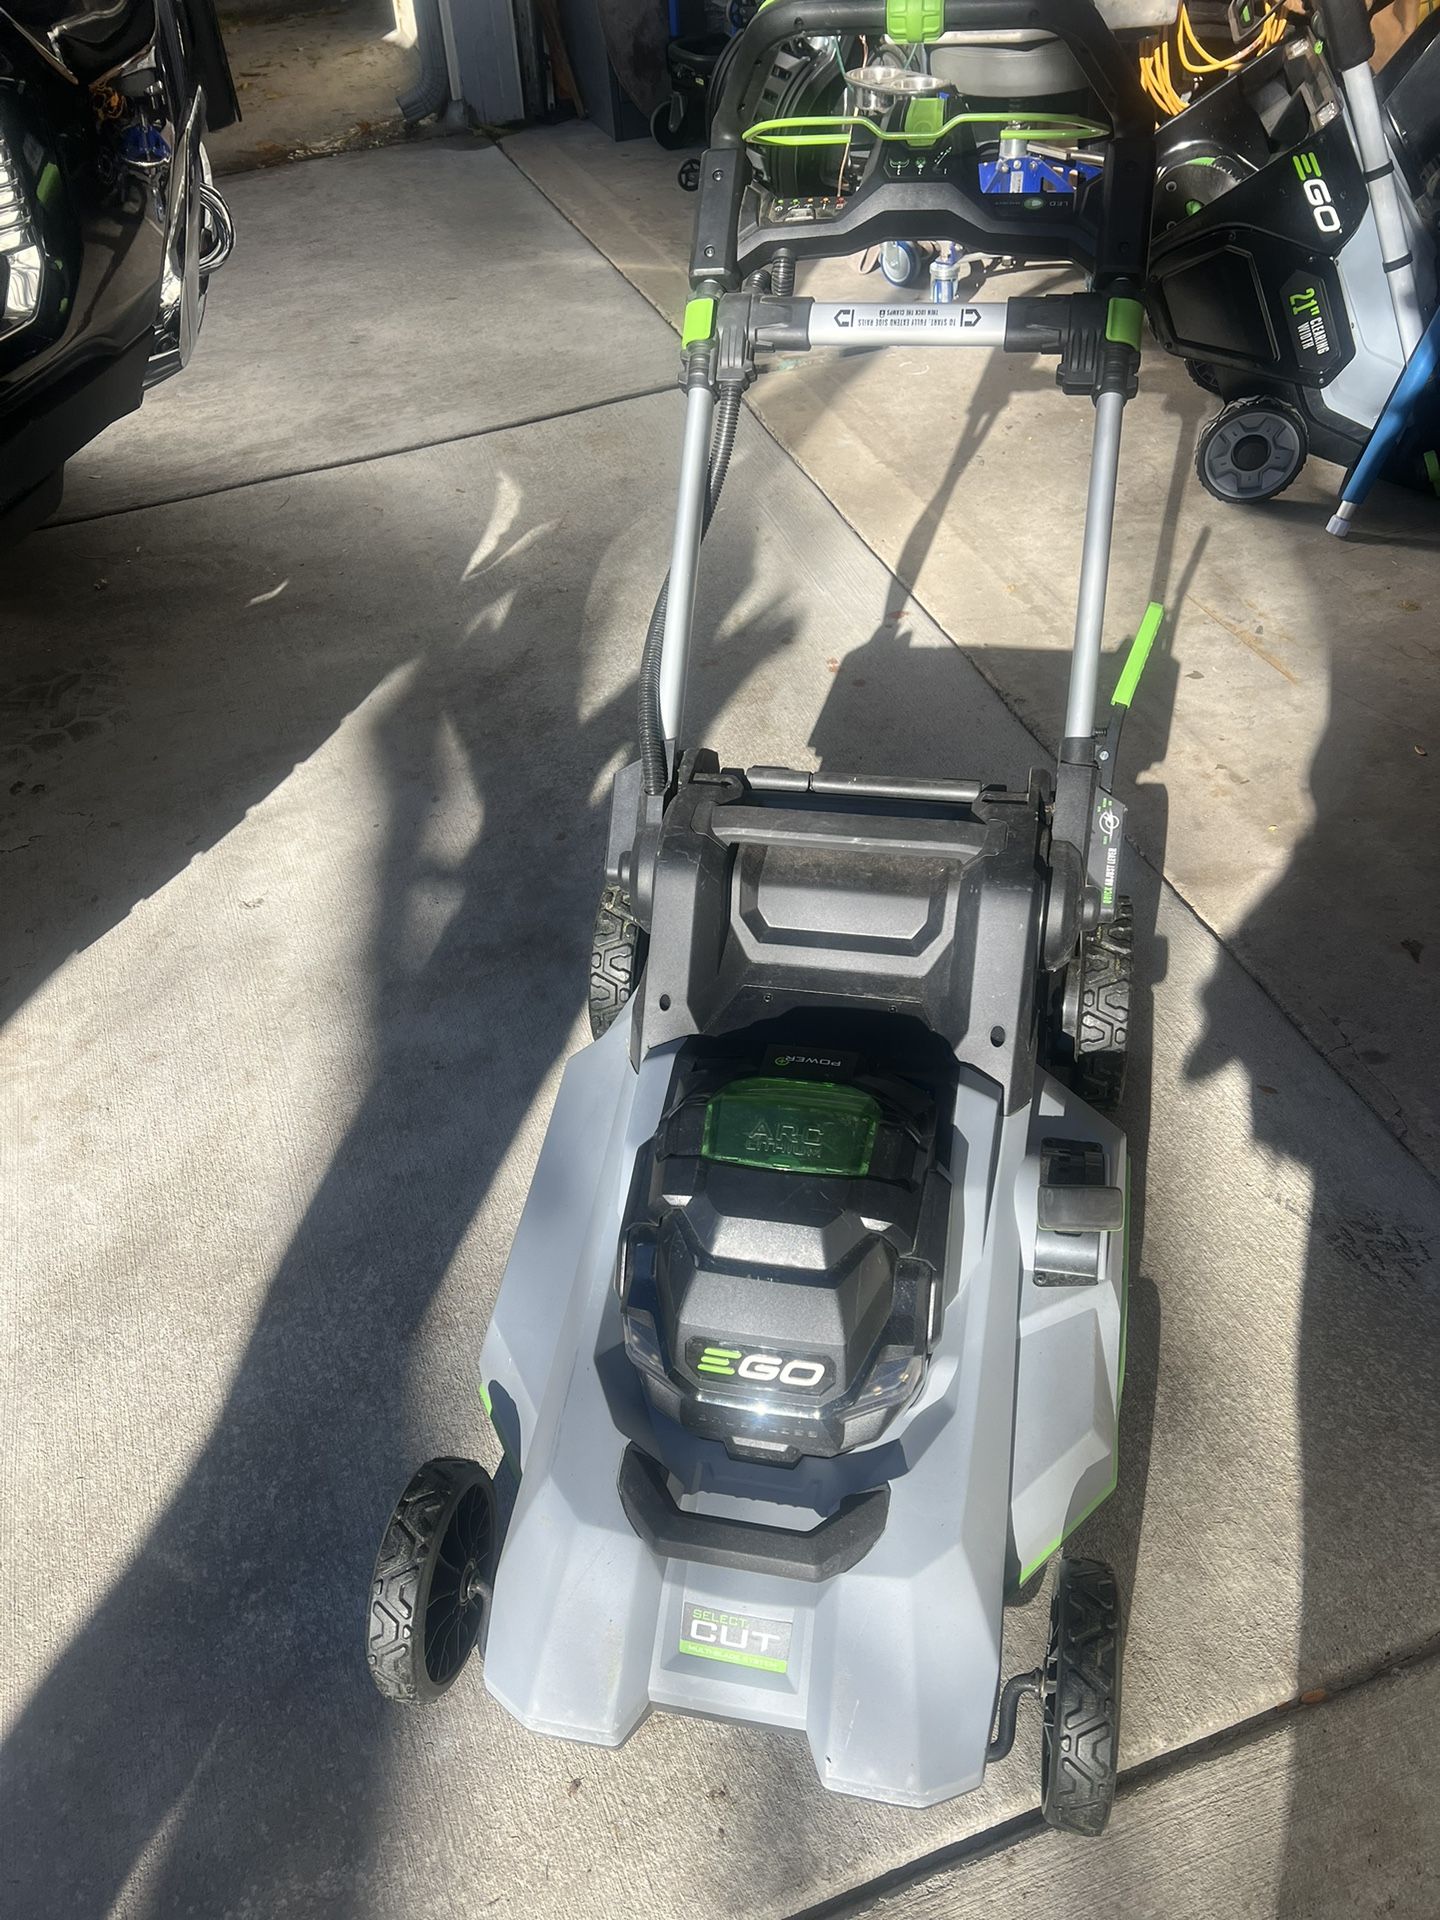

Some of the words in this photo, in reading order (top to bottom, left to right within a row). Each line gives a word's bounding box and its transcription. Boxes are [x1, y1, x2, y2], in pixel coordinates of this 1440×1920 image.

[1292, 151, 1341, 233] EGO
[857, 318, 874, 327] RAILS
[875, 318, 889, 326] SIDE
[889, 318, 910, 326] EXTEND
[910, 318, 927, 326] FULLY
[949, 318, 957, 326] TO
[1297, 321, 1314, 350] WIDTH
[1309, 316, 1330, 355] CLEARING
[1107, 847, 1118, 865] LEVER
[1104, 864, 1116, 887] ADJUST
[1102, 886, 1113, 904] QUICK
[748, 1120, 825, 1147] ARC
[746, 1139, 822, 1158] LITHIUM
[696, 1347, 826, 1387] EGO
[692, 1608, 747, 1628] SELECT
[690, 1619, 781, 1652] CUT
